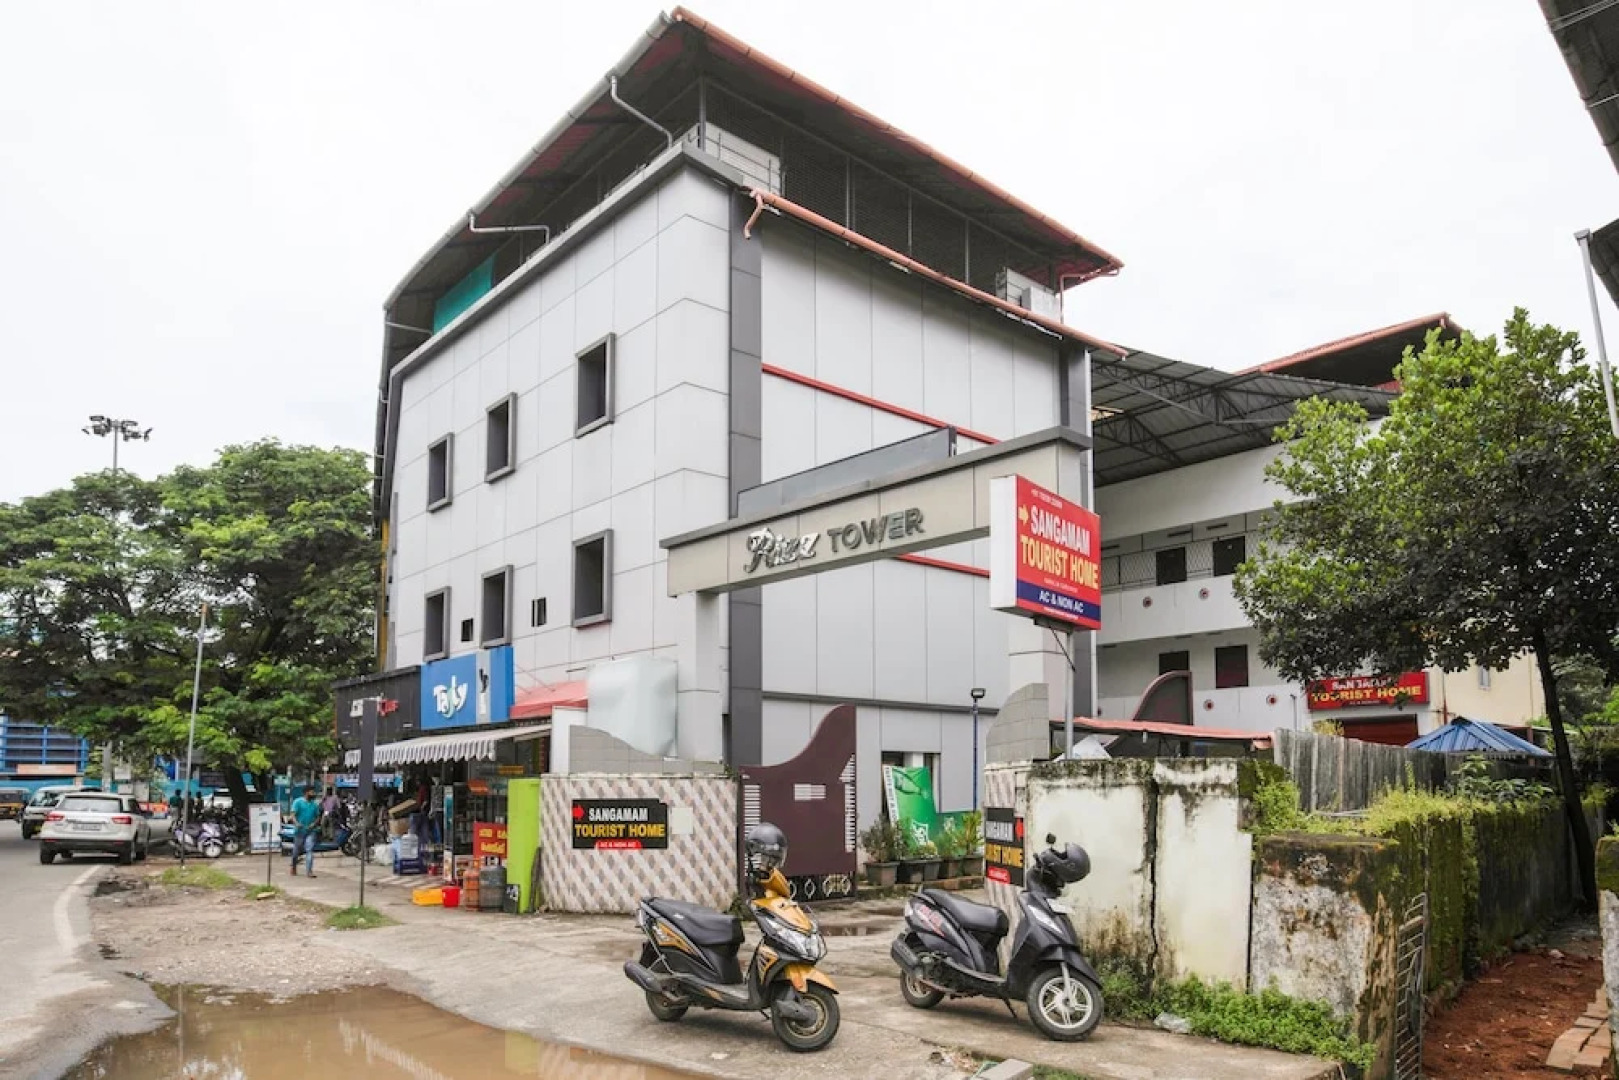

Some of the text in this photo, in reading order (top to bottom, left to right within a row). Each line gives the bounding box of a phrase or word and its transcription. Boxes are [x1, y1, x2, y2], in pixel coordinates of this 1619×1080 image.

[827, 508, 924, 552] TOWER
[1031, 505, 1090, 557] SANGAMAM
[1021, 534, 1099, 589] TOURIST HOME
[1039, 590, 1050, 603] AC
[1057, 595, 1073, 610] NON
[1073, 600, 1084, 613] AC
[574, 823, 665, 837] TOURIST HOME
[588, 807, 648, 821] SANGAMAM
